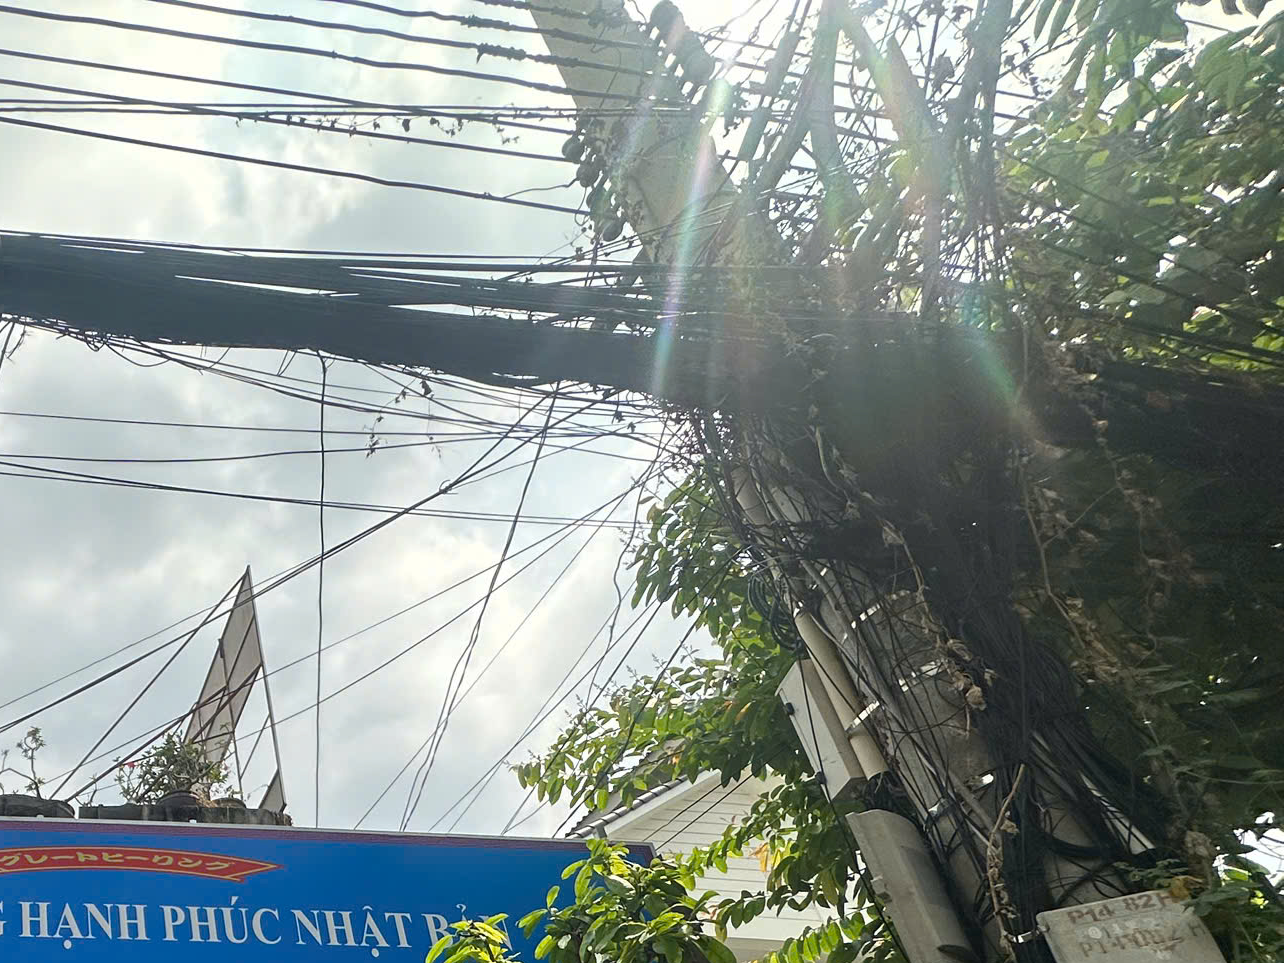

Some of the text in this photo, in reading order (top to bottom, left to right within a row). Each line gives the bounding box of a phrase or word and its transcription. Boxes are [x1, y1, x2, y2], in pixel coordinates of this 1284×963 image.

[18, 901, 150, 949] HẠNH
[155, 895, 282, 945] PHÚC
[290, 905, 412, 958] NHẬT
